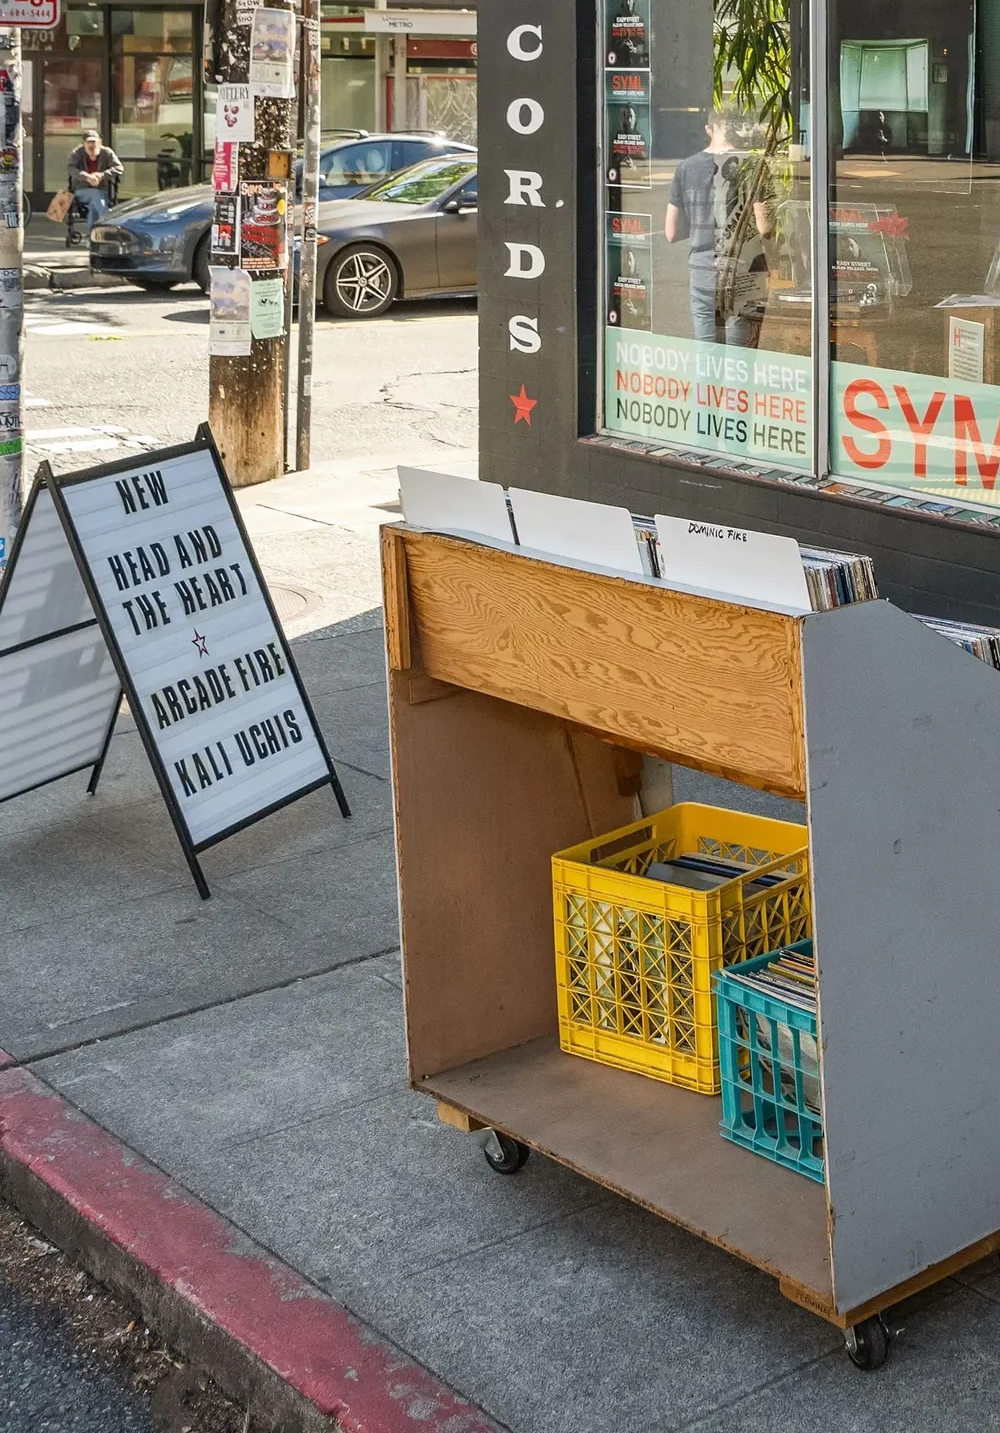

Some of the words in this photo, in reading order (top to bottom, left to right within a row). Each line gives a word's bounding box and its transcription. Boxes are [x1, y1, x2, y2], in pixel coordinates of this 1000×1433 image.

[612, 74, 644, 90] SYML
[616, 341, 690, 373] NOBODY
[696, 355, 748, 383] LIVES
[754, 362, 807, 393] HERE
[616, 369, 690, 402] NOBODY
[696, 382, 748, 413] LIVES
[754, 392, 806, 424] HERE
[616, 398, 691, 431] NOBODY
[697, 412, 748, 443] LIVES
[754, 423, 806, 454] HERE
[115, 469, 169, 516] NEW
[107, 542, 171, 591] HEAD
[173, 525, 222, 569] AND
[688, 522, 723, 539] DOMINIC
[727, 529, 747, 542] FIKE
[122, 590, 171, 636] THE
[174, 563, 248, 616] HEART
[151, 663, 236, 730] ARCADE
[235, 642, 285, 692] FIRE
[174, 741, 234, 798] KALI
[234, 709, 303, 766] UCHIS
